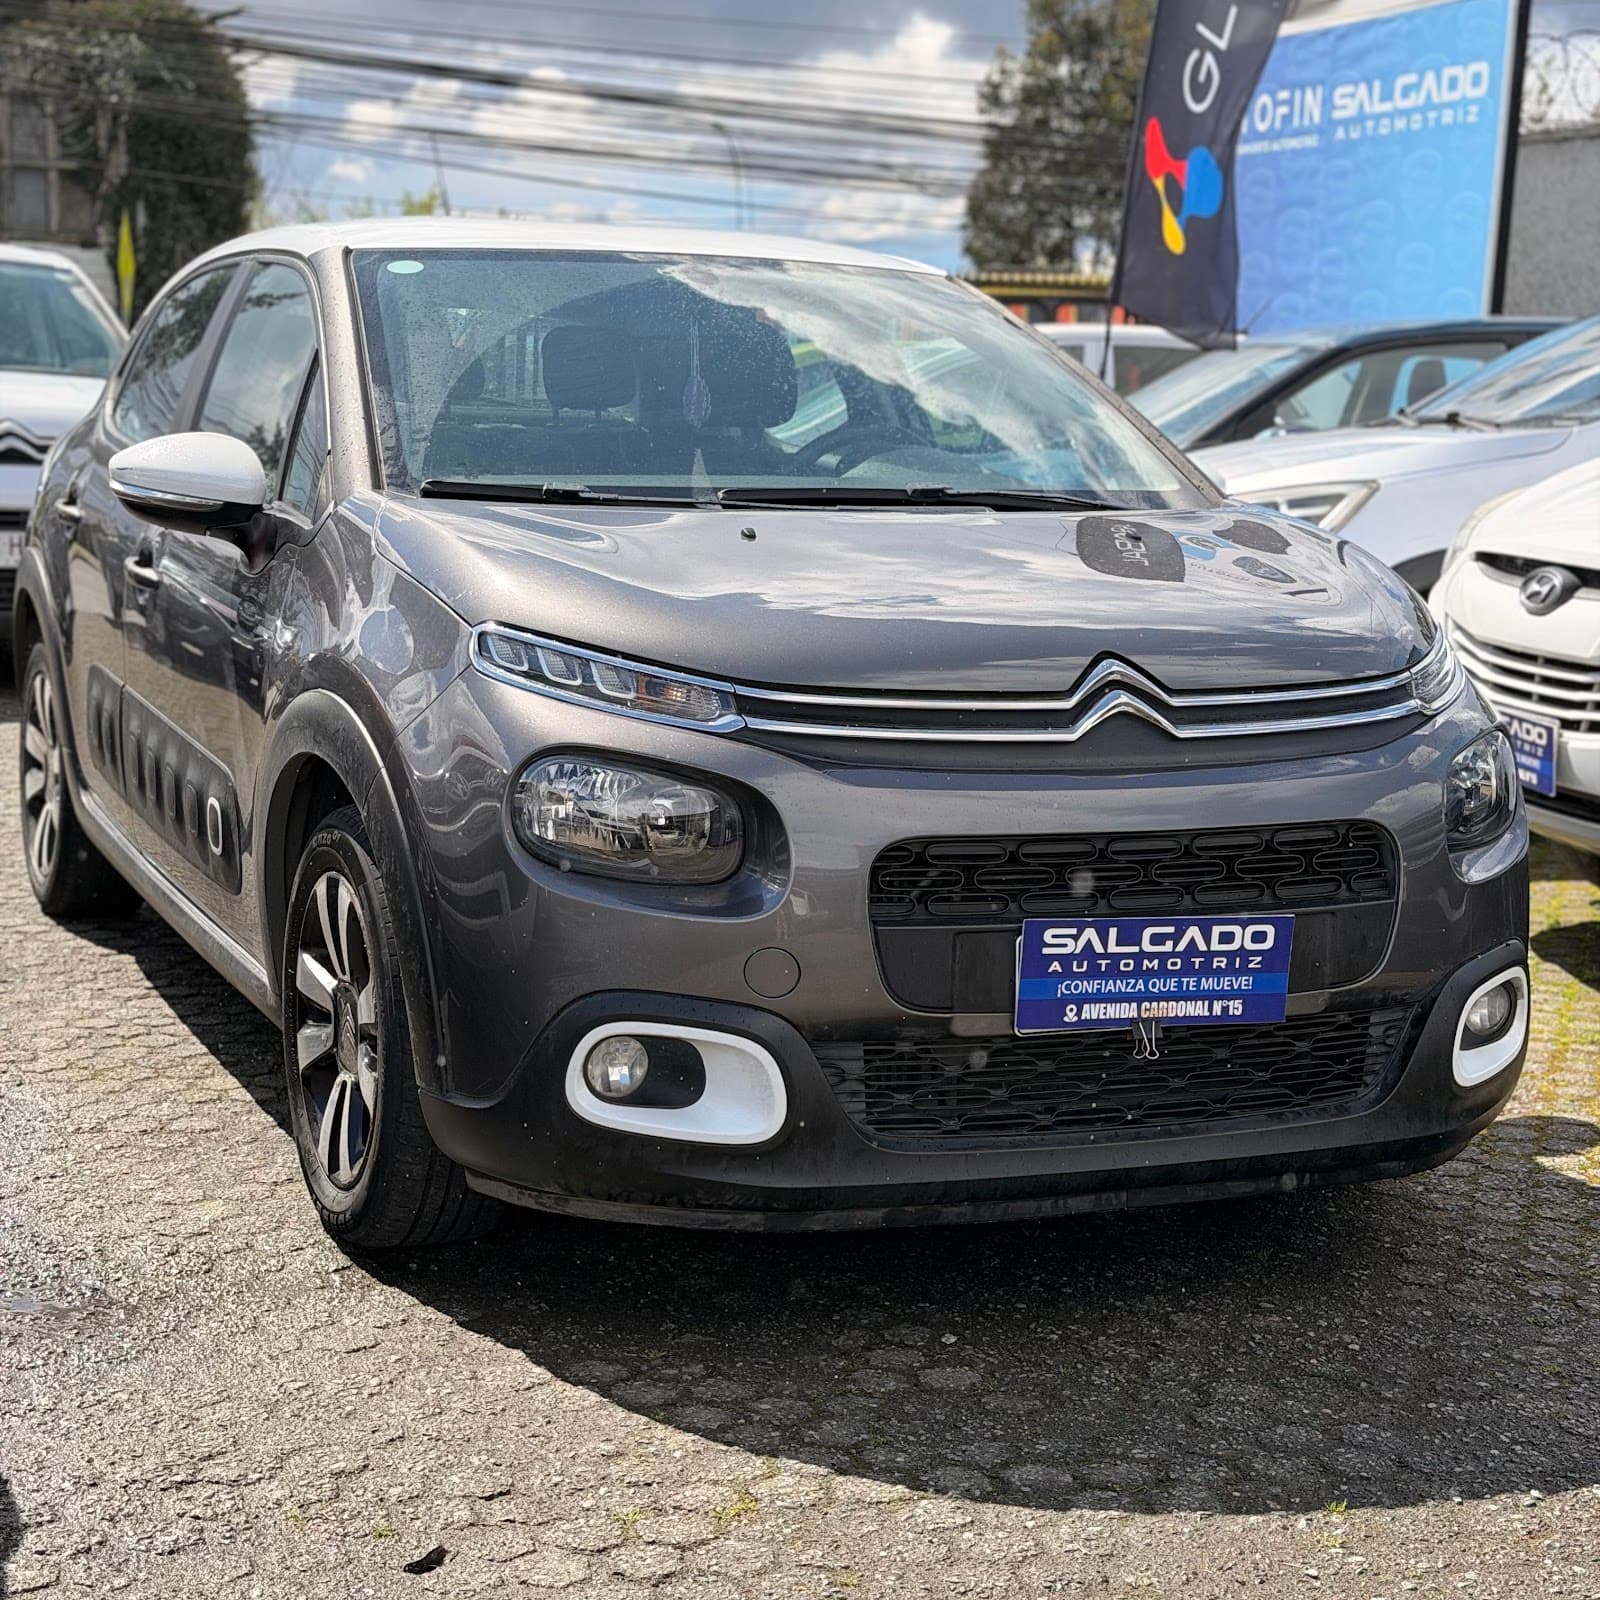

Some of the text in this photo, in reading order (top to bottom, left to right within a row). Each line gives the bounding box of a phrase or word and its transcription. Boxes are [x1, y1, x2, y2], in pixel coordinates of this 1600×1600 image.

[1182, 4, 1238, 114] GL
[1331, 61, 1490, 120] SALGADO
[1334, 104, 1480, 140] AUTOMOTRIZ
[1042, 924, 1276, 955] SALGADO
[1048, 956, 1263, 973] AUTOMOTRIZ
[1057, 975, 1253, 998] ¡CONFIANZA QUE TE MUEVE!
[1081, 1002, 1138, 1020] AVENIDA
[1140, 1000, 1210, 1018] CARDONAL
